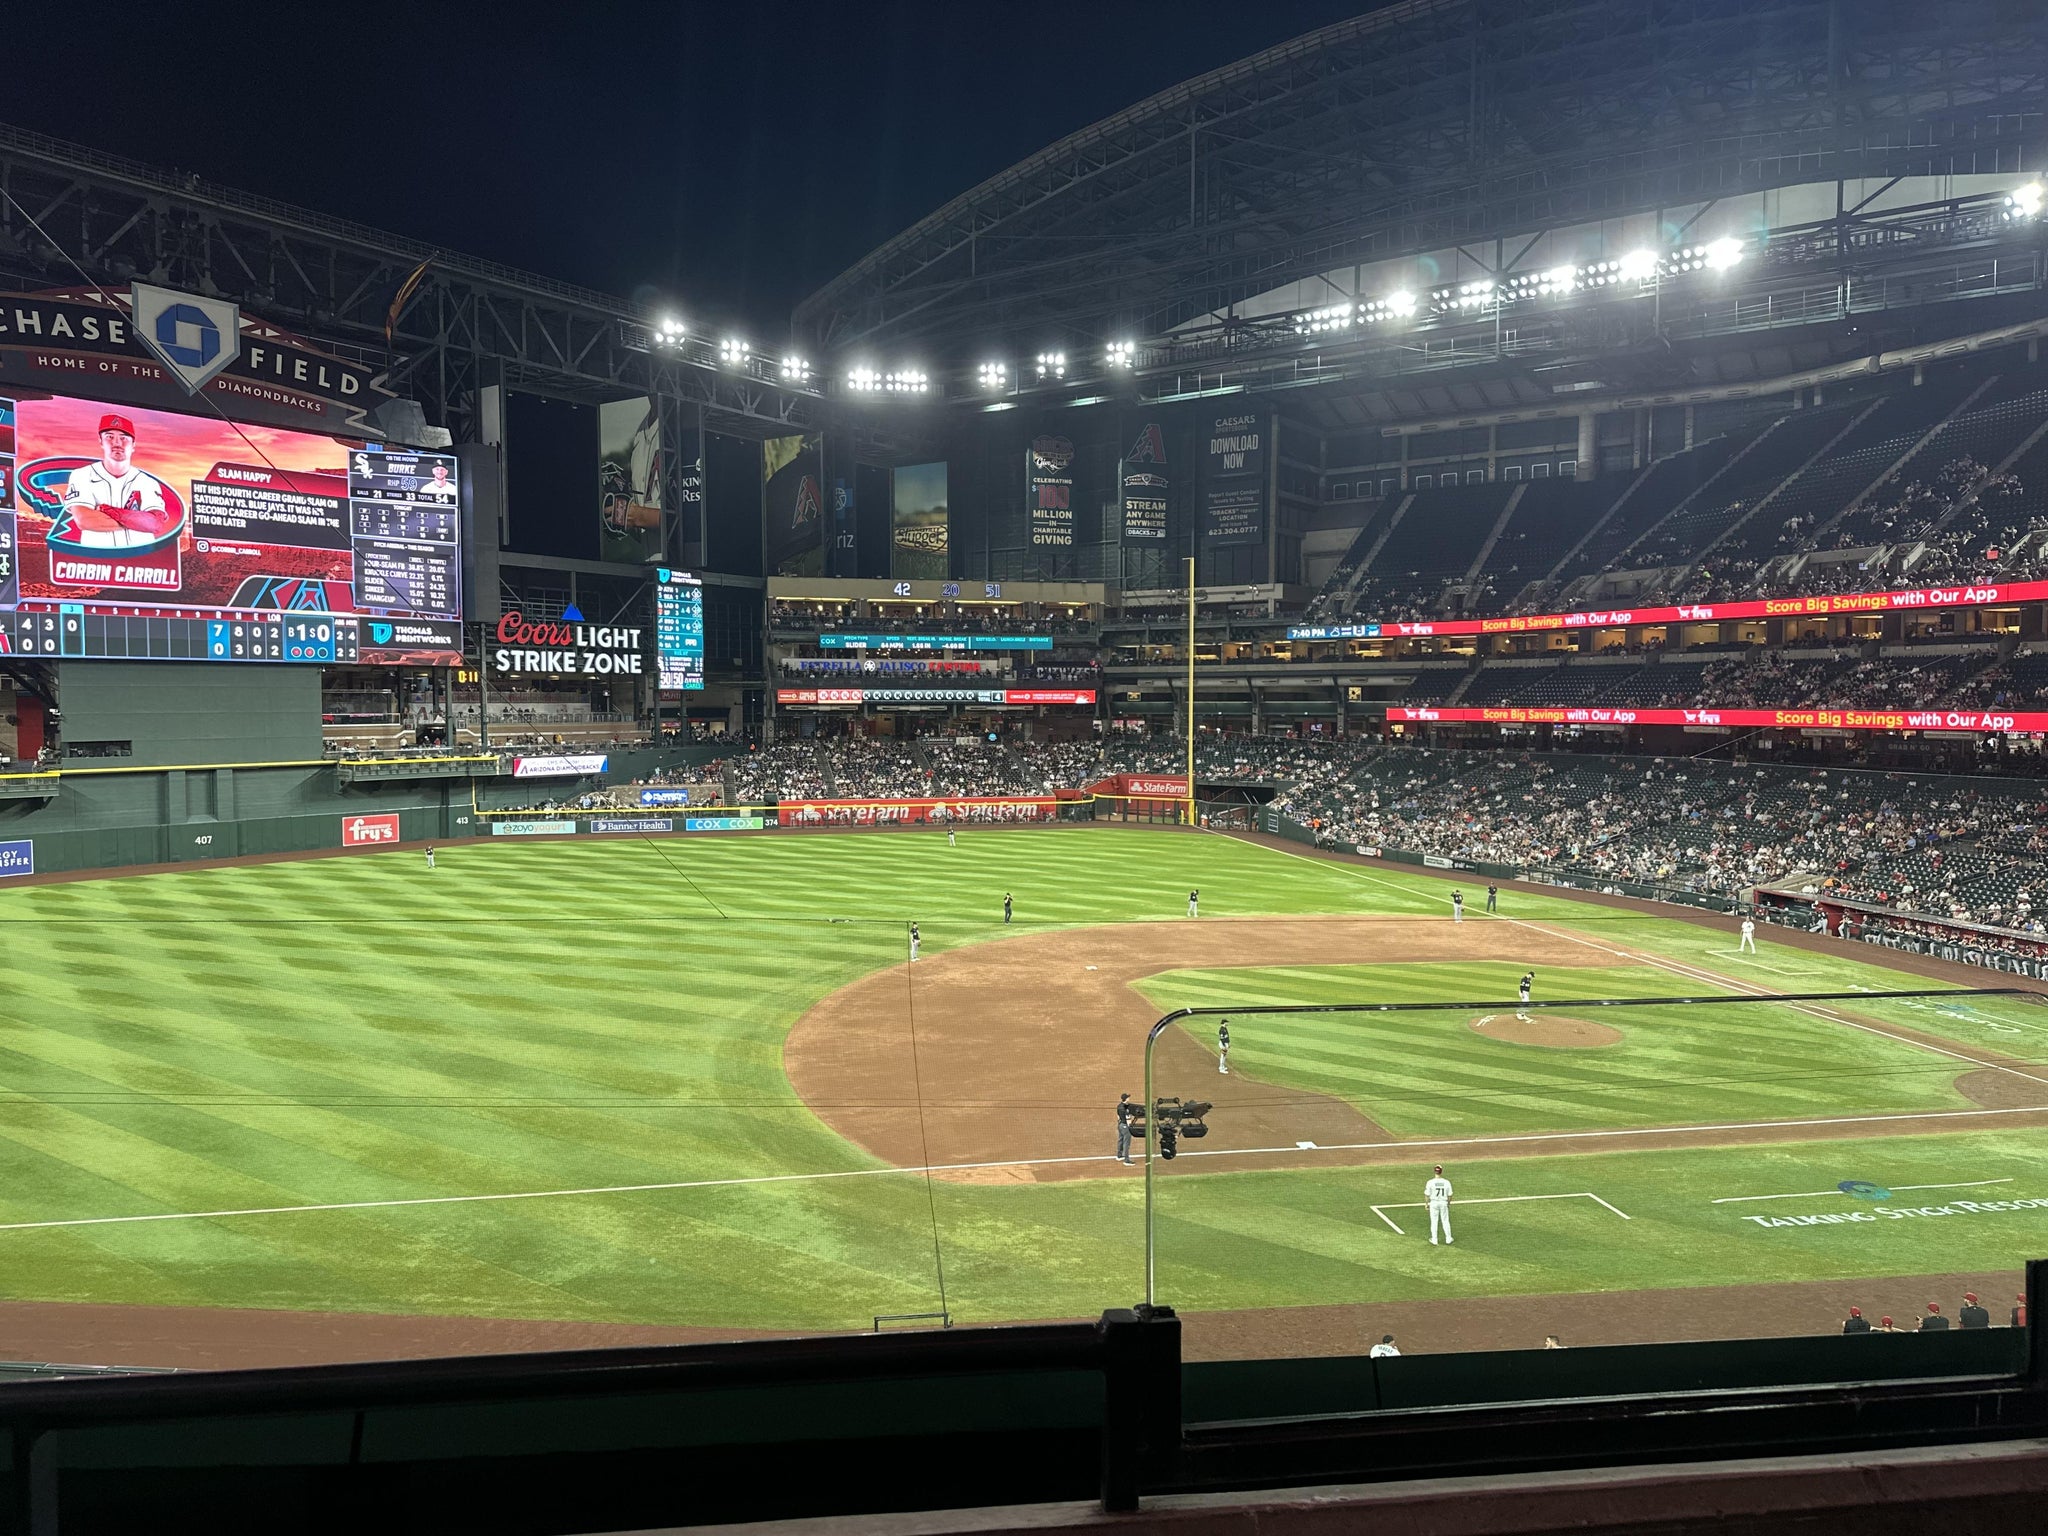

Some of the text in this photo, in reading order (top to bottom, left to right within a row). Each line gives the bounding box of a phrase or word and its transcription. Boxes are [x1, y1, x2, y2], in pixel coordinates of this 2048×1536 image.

[38, 356, 161, 379] HOME OF THE
[251, 347, 360, 395] FIELD
[219, 380, 322, 413] DIAMONDBACKS
[1215, 415, 1256, 428] CAESARS
[1210, 434, 1259, 455] DOWNLOAD
[1223, 452, 1245, 470] NOW
[217, 467, 272, 484] SLAM HAPPY
[387, 463, 417, 475] BURKE
[400, 477, 418, 491] 59
[1033, 477, 1073, 485] CELEBRATING
[194, 483, 208, 493] HIT
[208, 484, 221, 495] HIS
[222, 486, 251, 498] FOURTH
[252, 490, 281, 502] CAREER
[282, 494, 307, 505] GRAND
[307, 497, 326, 508] SLAM
[373, 490, 382, 498] 21
[406, 493, 416, 501] 33
[435, 494, 449, 503] 54
[194, 494, 235, 508] SATURDAY
[236, 498, 247, 508] VS.
[249, 500, 267, 510] BLUE
[268, 502, 287, 512] JAYS.
[287, 504, 294, 513] IT
[295, 505, 311, 516] WAS
[1126, 500, 1166, 511] STREAM
[194, 515, 247, 528] 7TH OR LATER
[196, 504, 228, 516] SECOND
[229, 507, 258, 520] CAREER
[258, 511, 297, 524] GO-AHEAD
[297, 515, 317, 526] SLAM
[1033, 510, 1073, 520] MILLION
[1126, 511, 1166, 520] ANY GAME
[1126, 519, 1166, 528] ANYWHERE
[1033, 527, 1073, 535] CHARITABLE
[1033, 535, 1073, 545] GIVING
[56, 561, 178, 585] CORBIN CARROLL
[893, 582, 1001, 597] 42 20 51
[1765, 586, 1998, 613] Score Big Savings with Our App
[24, 603, 29, 611] 1
[46, 604, 51, 612] 2
[113, 607, 118, 615] 5
[134, 608, 140, 616] 6
[176, 610, 181, 618] 8
[195, 611, 201, 619] 9
[216, 611, 222, 619] R
[236, 612, 242, 620] H
[253, 613, 259, 621] E
[267, 613, 281, 622] LOB
[1482, 610, 1632, 631] Score Big Savings with Our App
[21, 618, 279, 639] 4 3 0 7 8 0 2
[288, 623, 356, 642] B 1 S 0 2 4
[395, 625, 432, 634] THOMAS
[496, 611, 573, 646] Coors
[576, 625, 641, 649] LIGHT
[1292, 629, 1326, 638] 7:40 PM
[22, 638, 356, 657] 0 0 0 3 0 2 2 2
[496, 649, 577, 674] STRIKE
[582, 652, 642, 674] ZONE
[800, 660, 926, 672] ESTRELLA JALISCO
[458, 670, 479, 683] 0:11
[1483, 708, 1636, 724] Score Big Savings with Our App
[1775, 711, 2014, 731] Score Big Savings with Our App
[456, 816, 469, 825] 413
[608, 821, 666, 831] Banner Health
[695, 819, 755, 829] COX COX
[765, 818, 779, 827] 374
[348, 818, 393, 841] fry's
[512, 823, 534, 833] zoyo
[194, 835, 213, 845] 407
[1435, 1187, 1445, 1197] 71
[1741, 1211, 1877, 1228] TALKING
[1873, 1204, 1965, 1220] STICK
